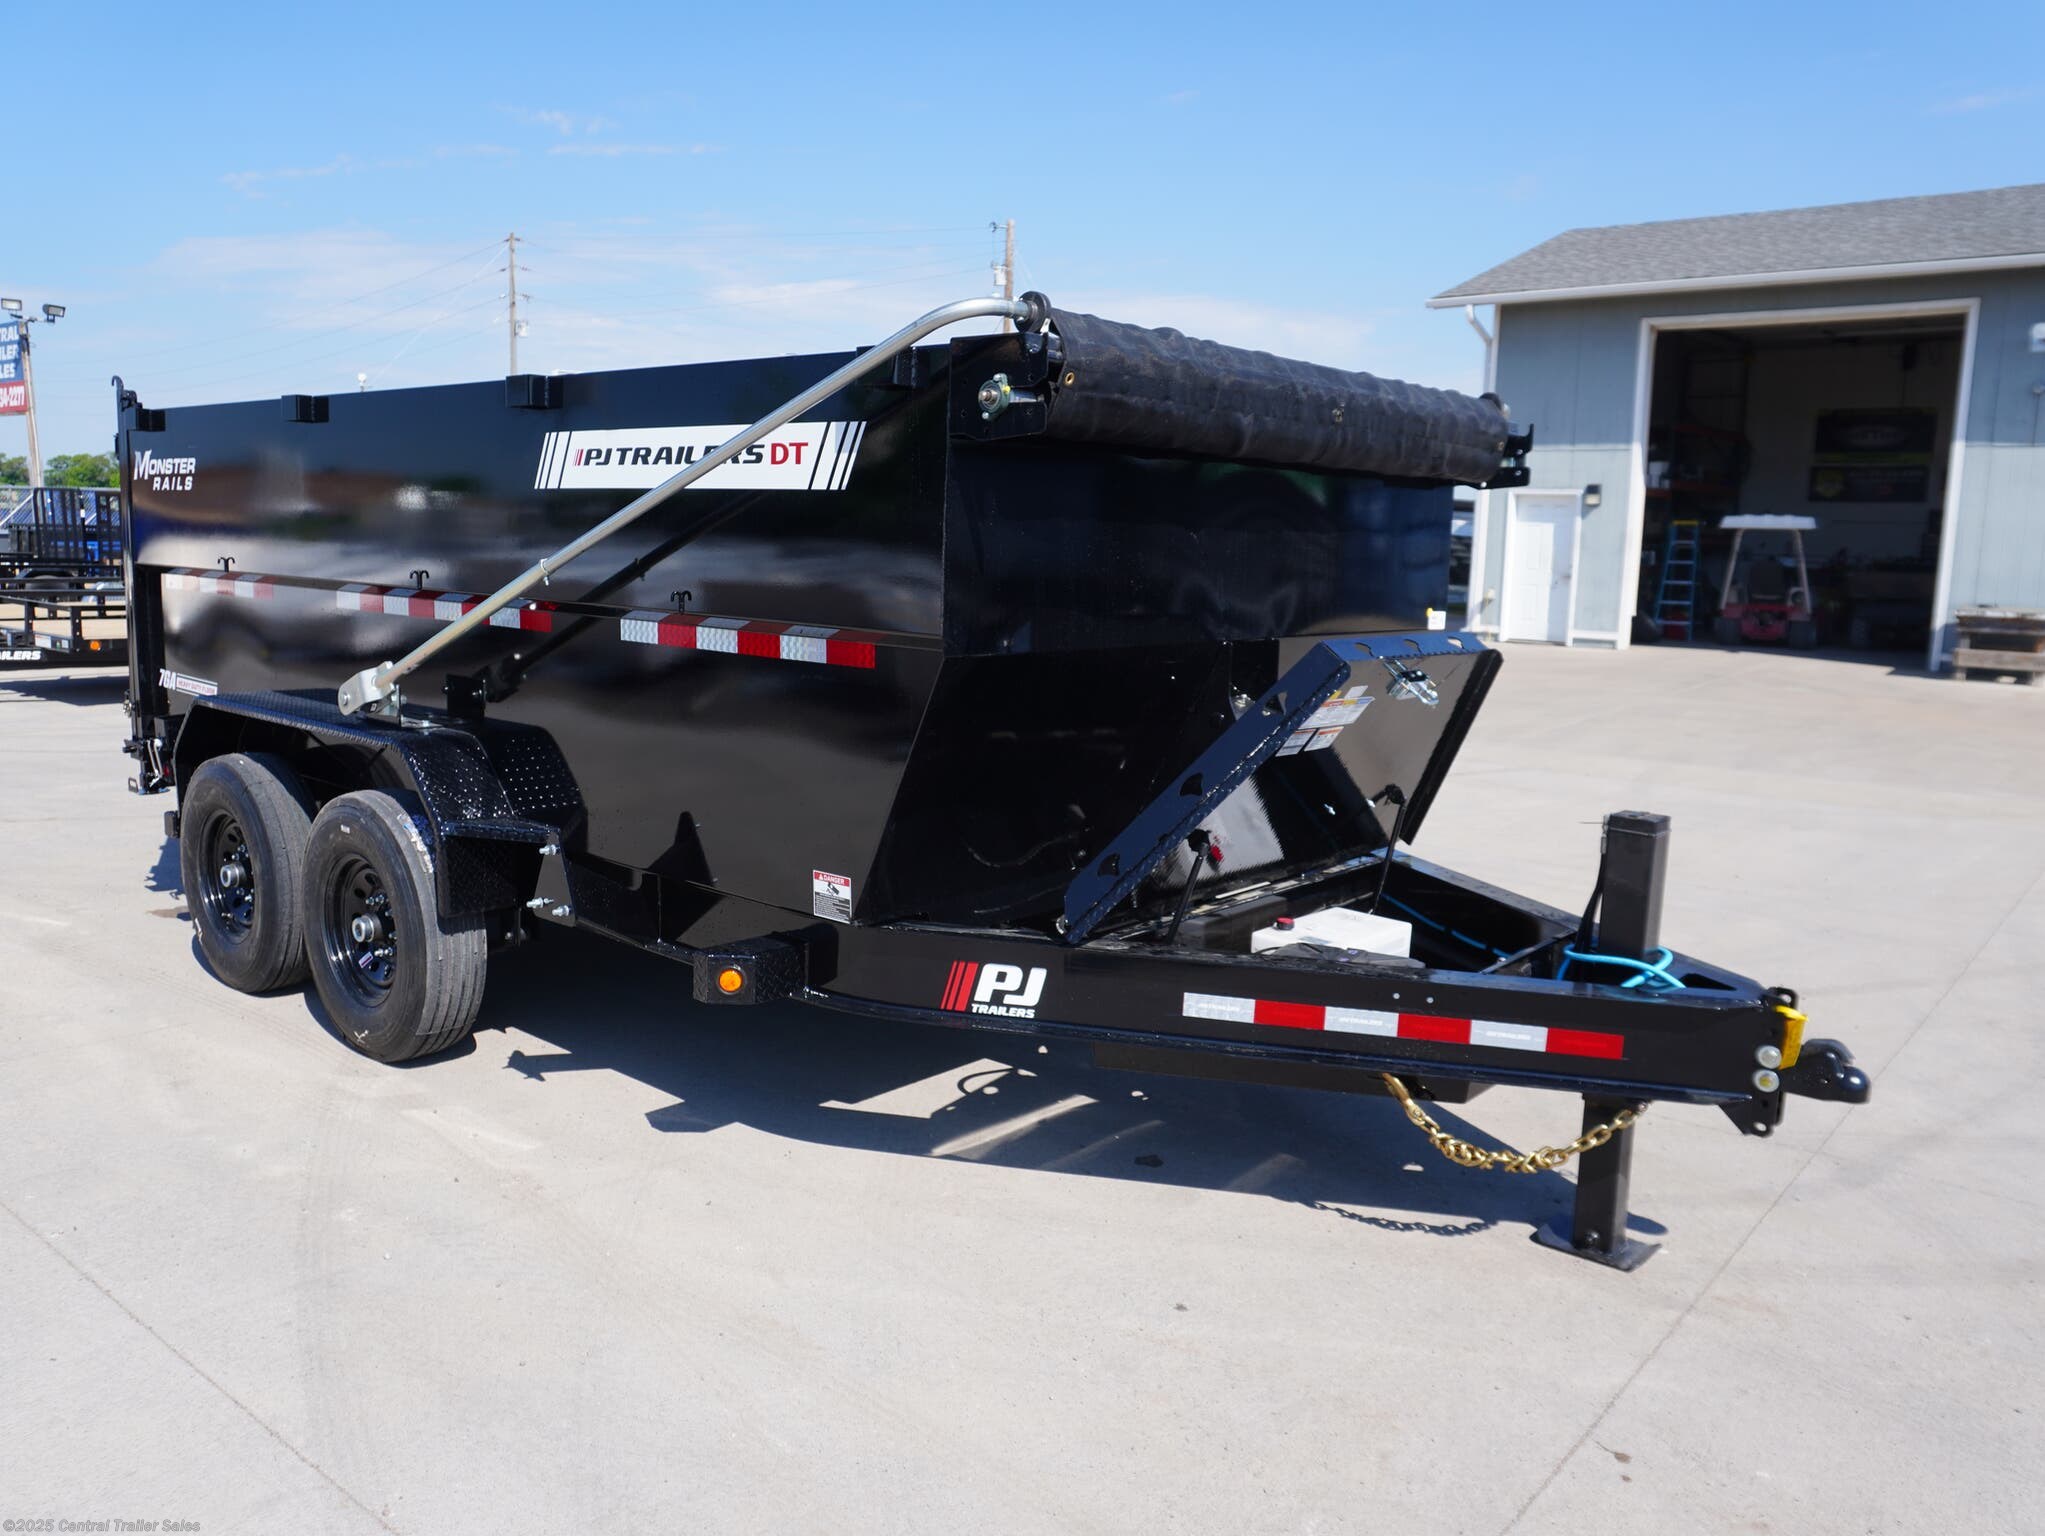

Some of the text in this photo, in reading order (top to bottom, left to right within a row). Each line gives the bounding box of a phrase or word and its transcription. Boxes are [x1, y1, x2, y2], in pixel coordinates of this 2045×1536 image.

[0, 326, 19, 342] RAL
[770, 442, 809, 465] DT
[152, 476, 193, 491] RAILS
[0, 650, 42, 660] ILERS
[973, 963, 1048, 1007] PJ
[971, 1003, 1036, 1019] TRAILERS
